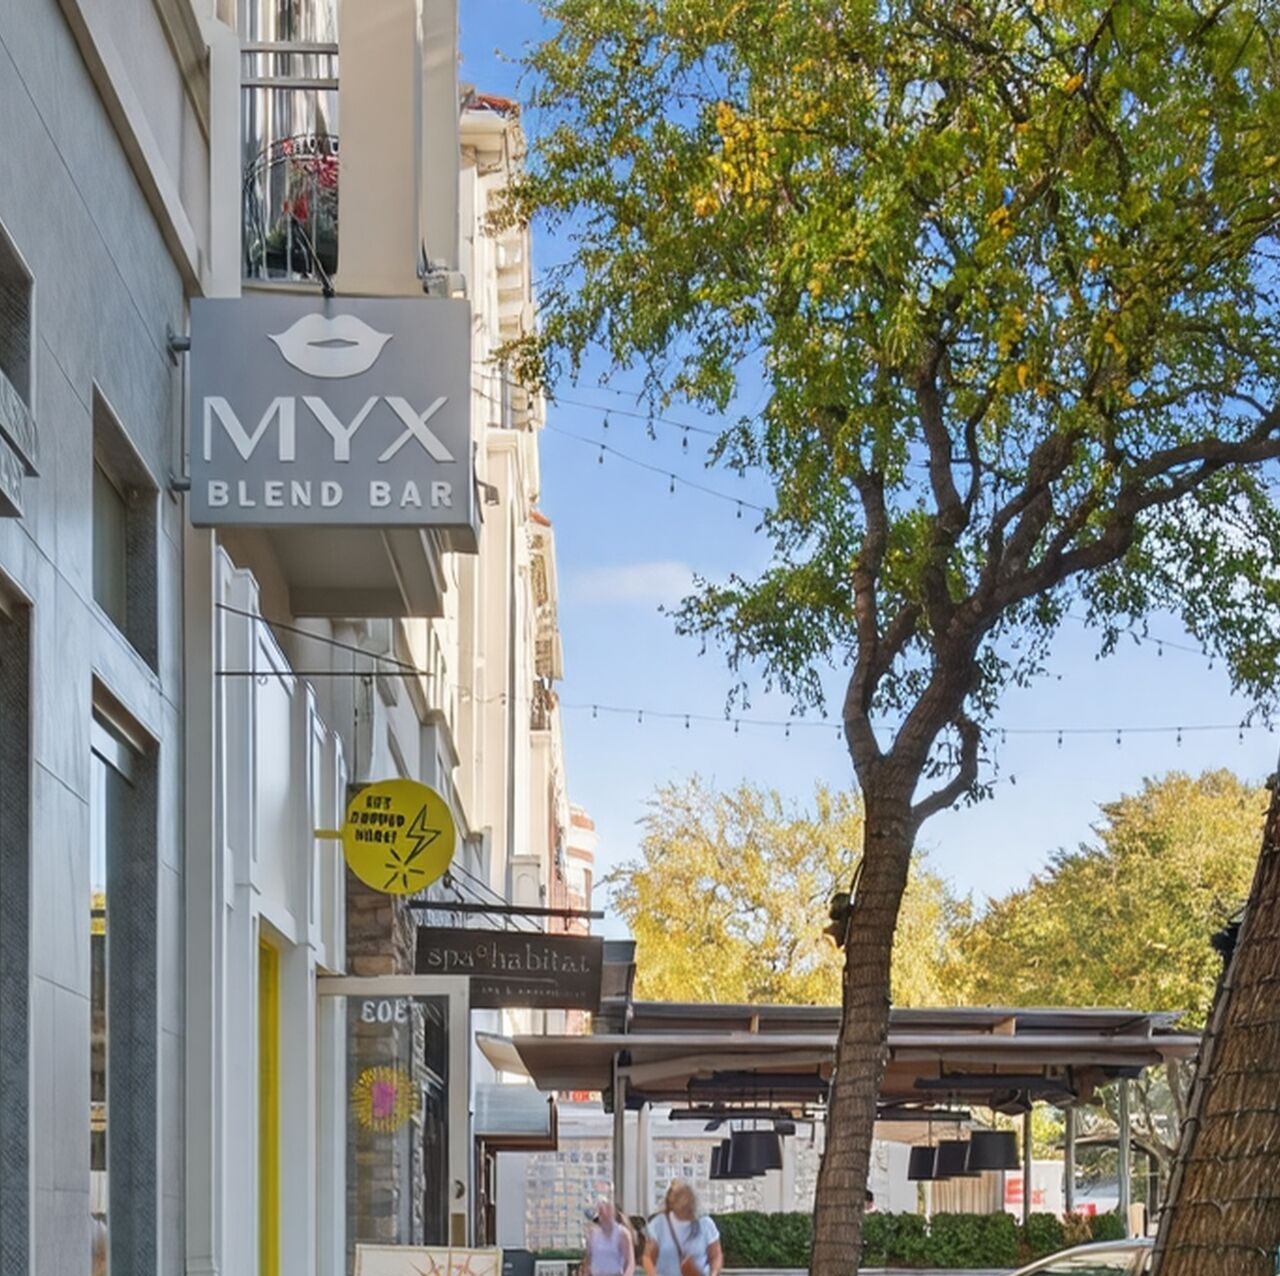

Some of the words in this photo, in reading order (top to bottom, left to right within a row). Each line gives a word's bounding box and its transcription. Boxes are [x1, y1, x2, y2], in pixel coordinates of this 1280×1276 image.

[203, 396, 457, 463] MYX
[207, 480, 344, 507] BLEND
[369, 480, 454, 508] BAR
